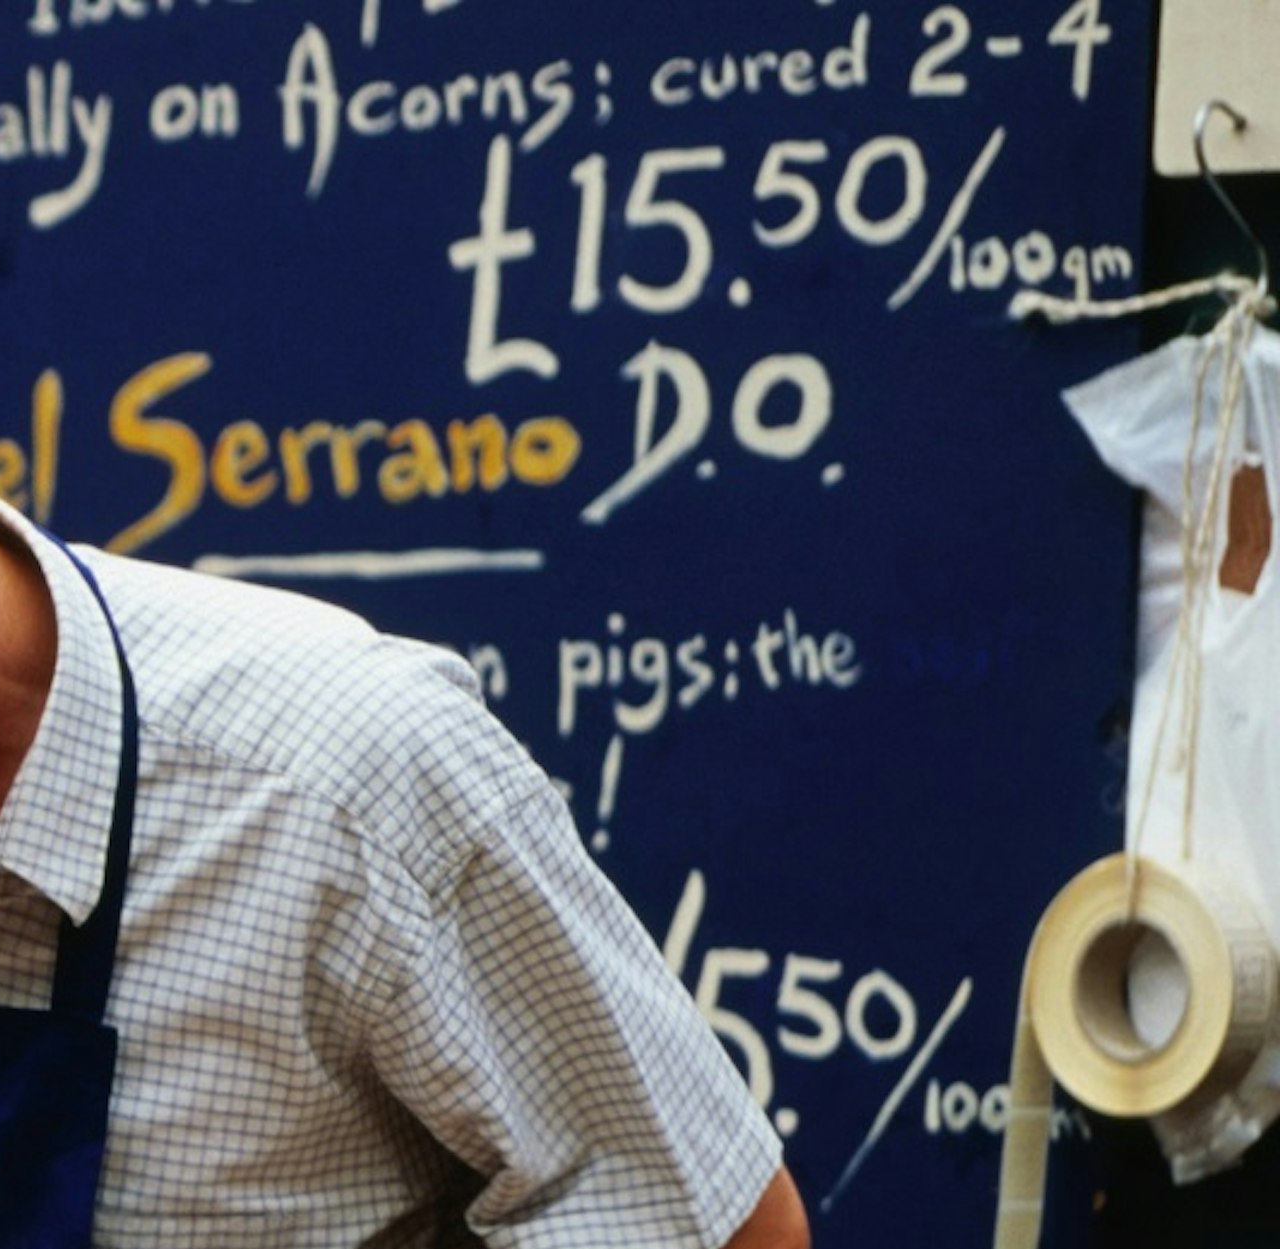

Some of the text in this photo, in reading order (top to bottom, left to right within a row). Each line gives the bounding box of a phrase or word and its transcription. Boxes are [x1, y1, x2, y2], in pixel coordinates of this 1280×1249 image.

[151, 84, 238, 141] on
[651, 13, 869, 105] cured
[102, 351, 582, 556] Serrano
